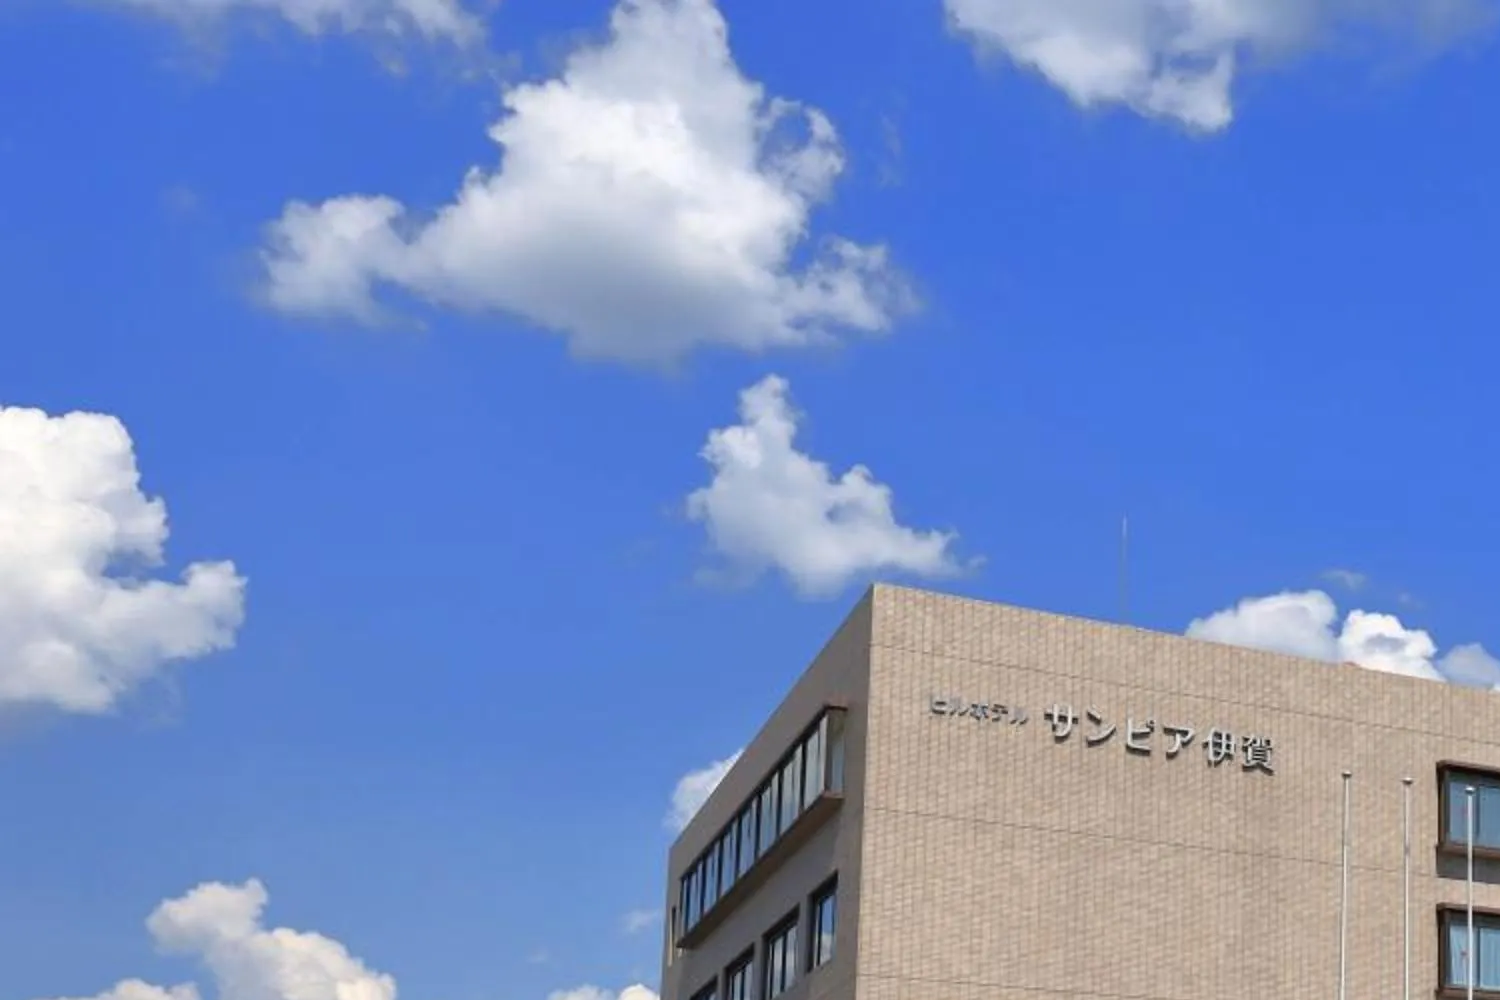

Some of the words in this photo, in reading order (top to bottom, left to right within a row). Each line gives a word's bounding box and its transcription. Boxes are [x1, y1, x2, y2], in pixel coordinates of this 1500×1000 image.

[1044, 702, 1275, 775] サンピア伊賀
